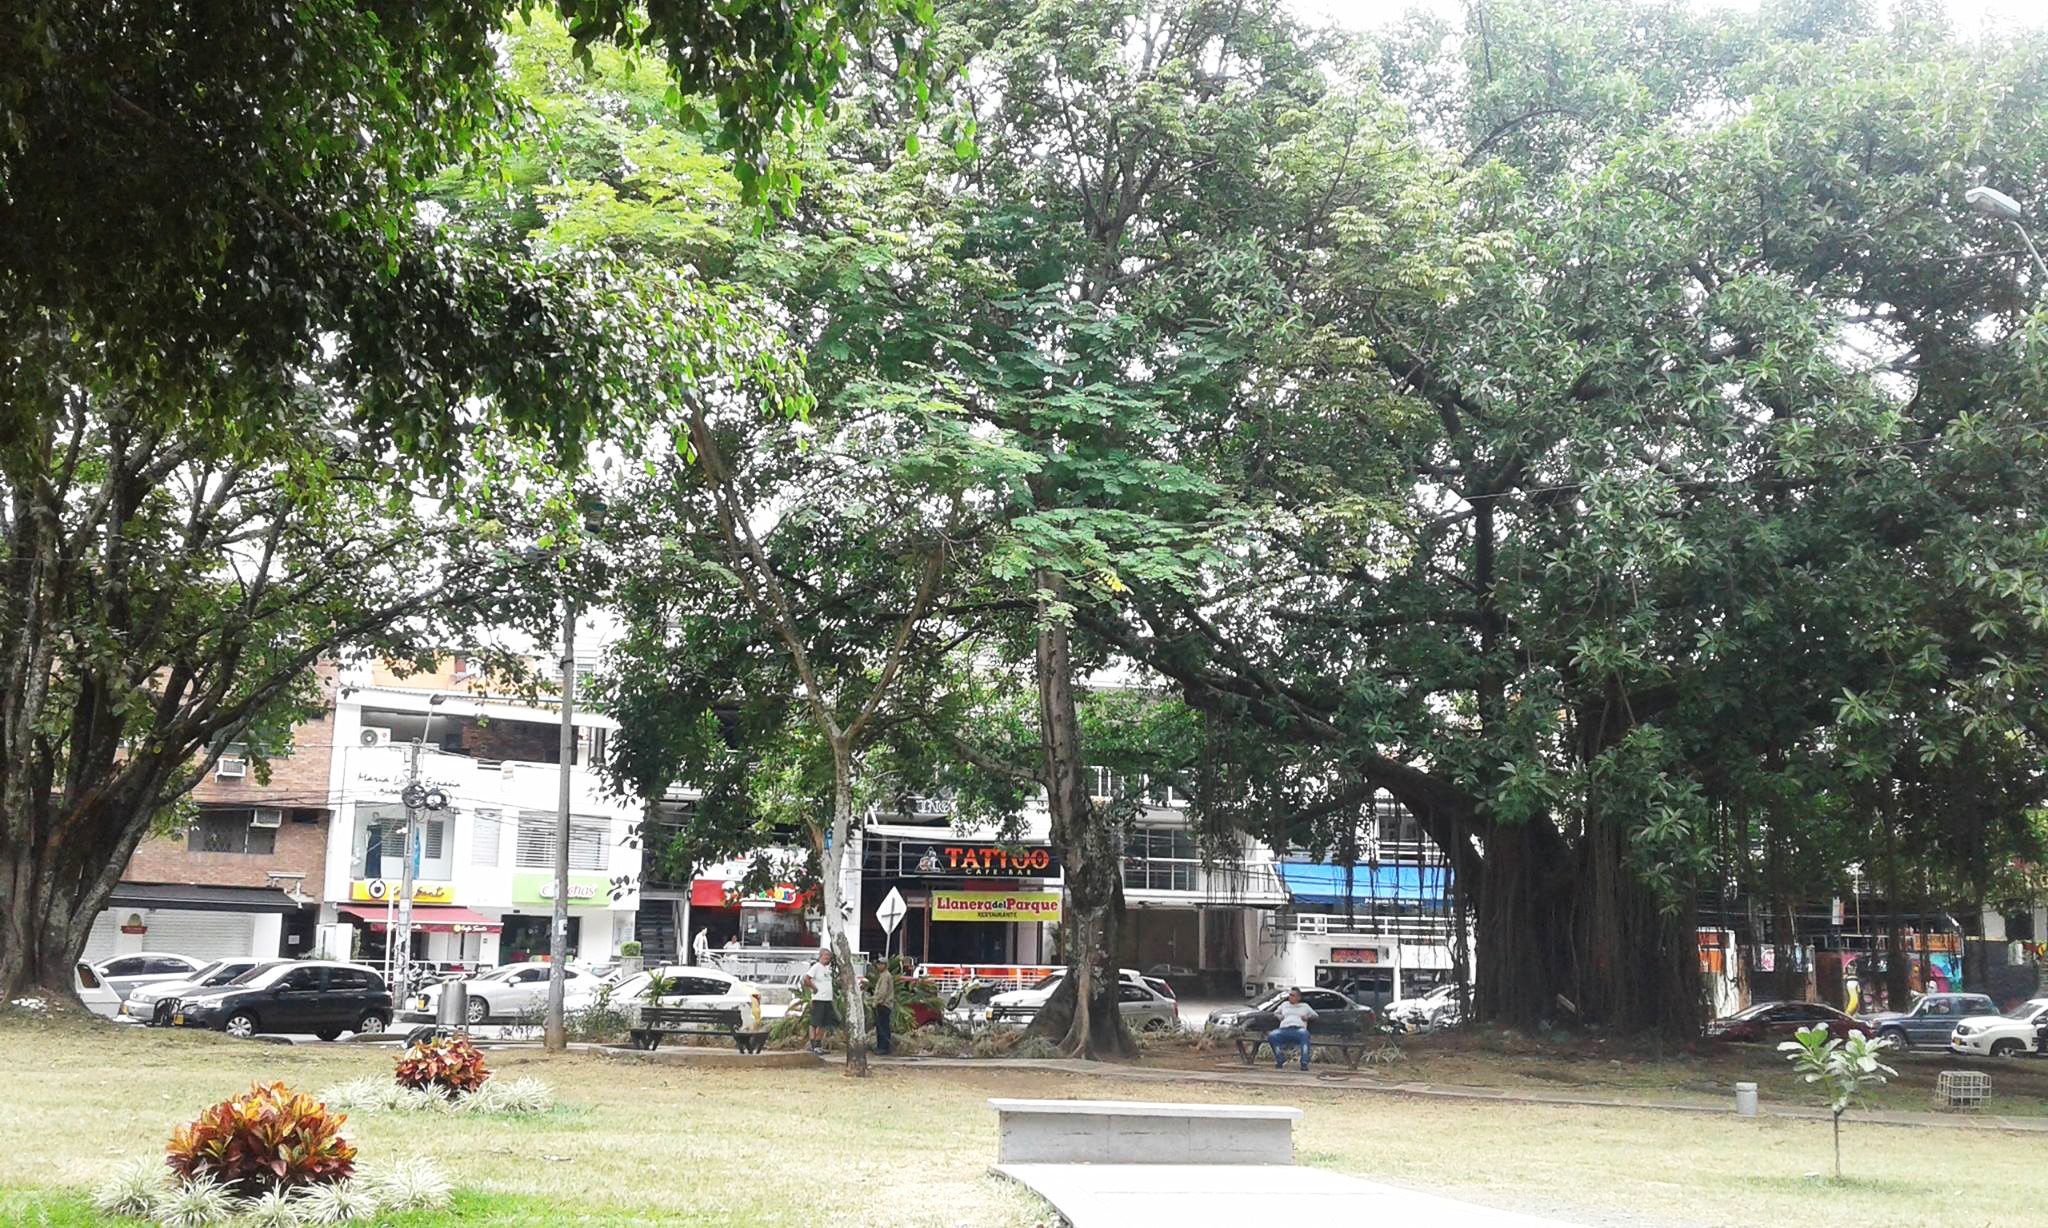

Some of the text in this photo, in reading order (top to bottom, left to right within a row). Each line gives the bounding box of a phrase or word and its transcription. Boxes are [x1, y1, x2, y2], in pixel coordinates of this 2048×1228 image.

[944, 847, 1050, 870] TATTOO
[936, 897, 1058, 914] Llanera del Parque
